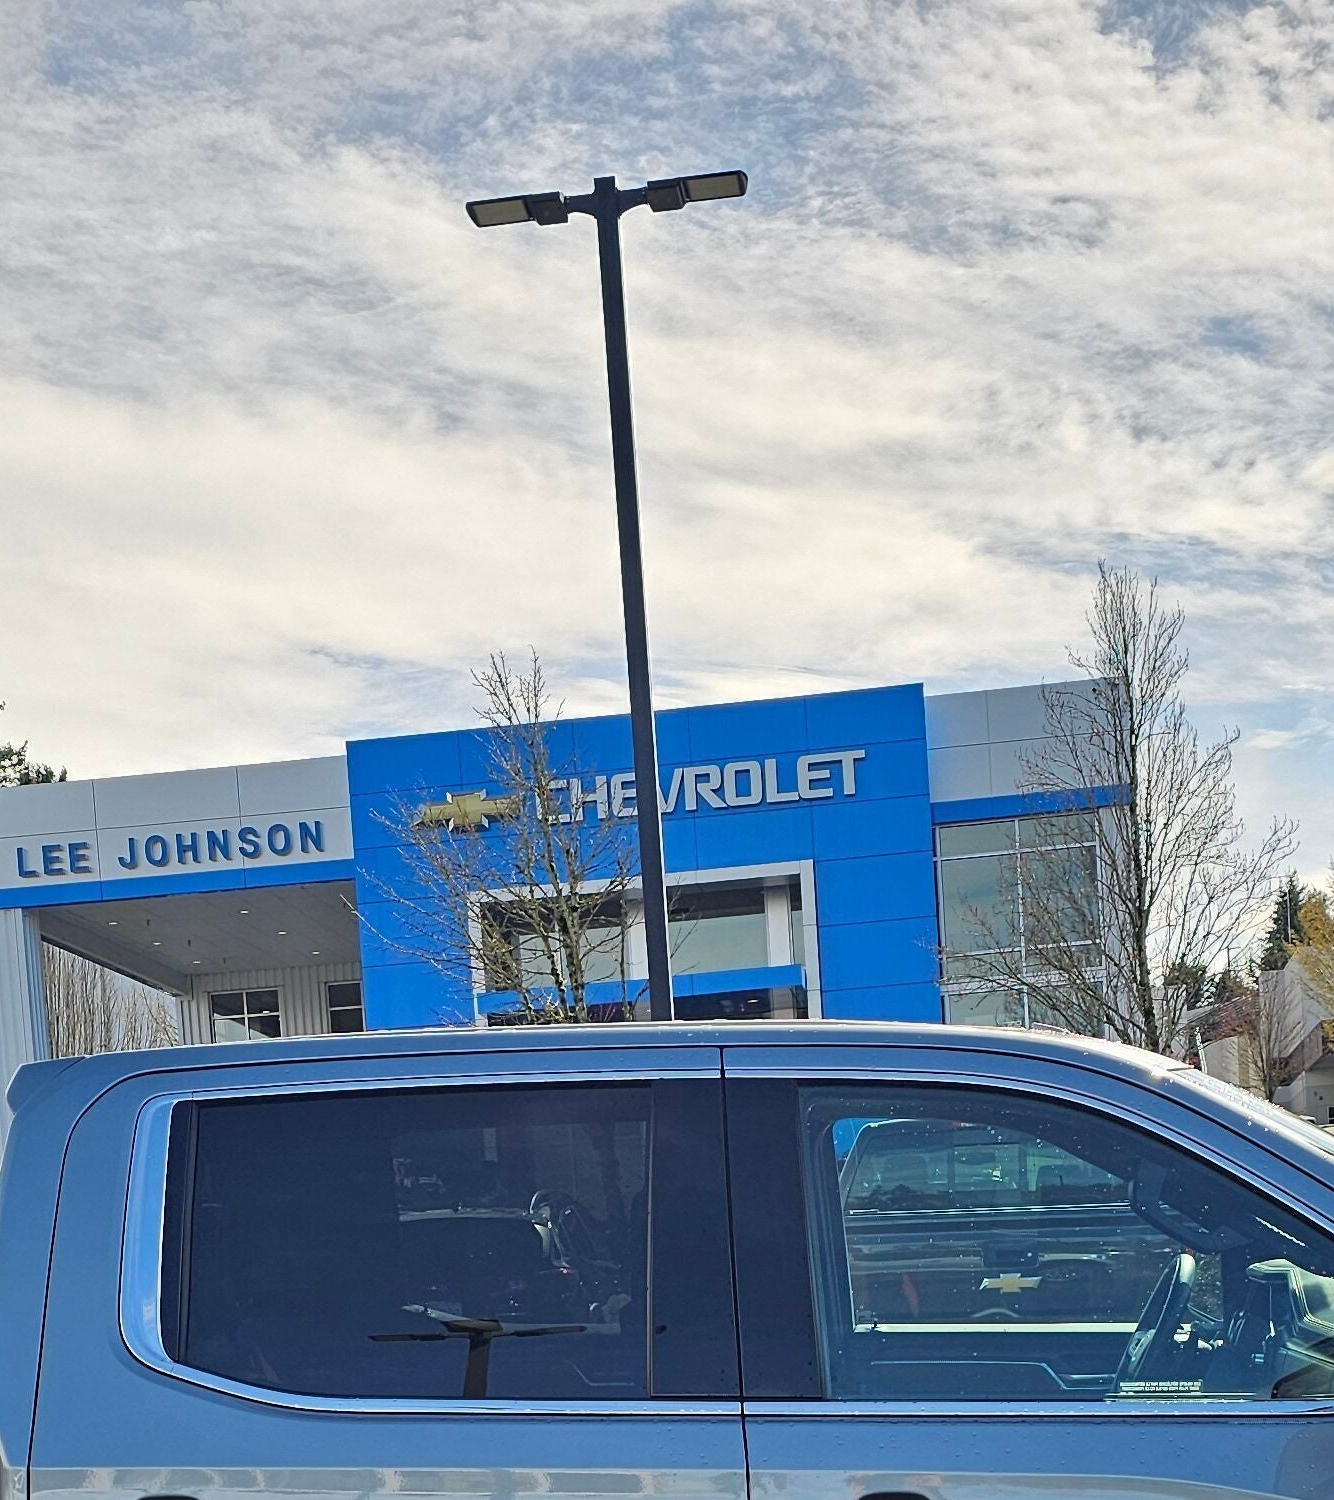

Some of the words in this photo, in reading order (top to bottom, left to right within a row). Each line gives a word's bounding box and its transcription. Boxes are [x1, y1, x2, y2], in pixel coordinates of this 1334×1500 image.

[535, 749, 866, 825] CHEVROLET
[16, 841, 93, 879] LEE
[117, 820, 326, 870] JOHNSON
